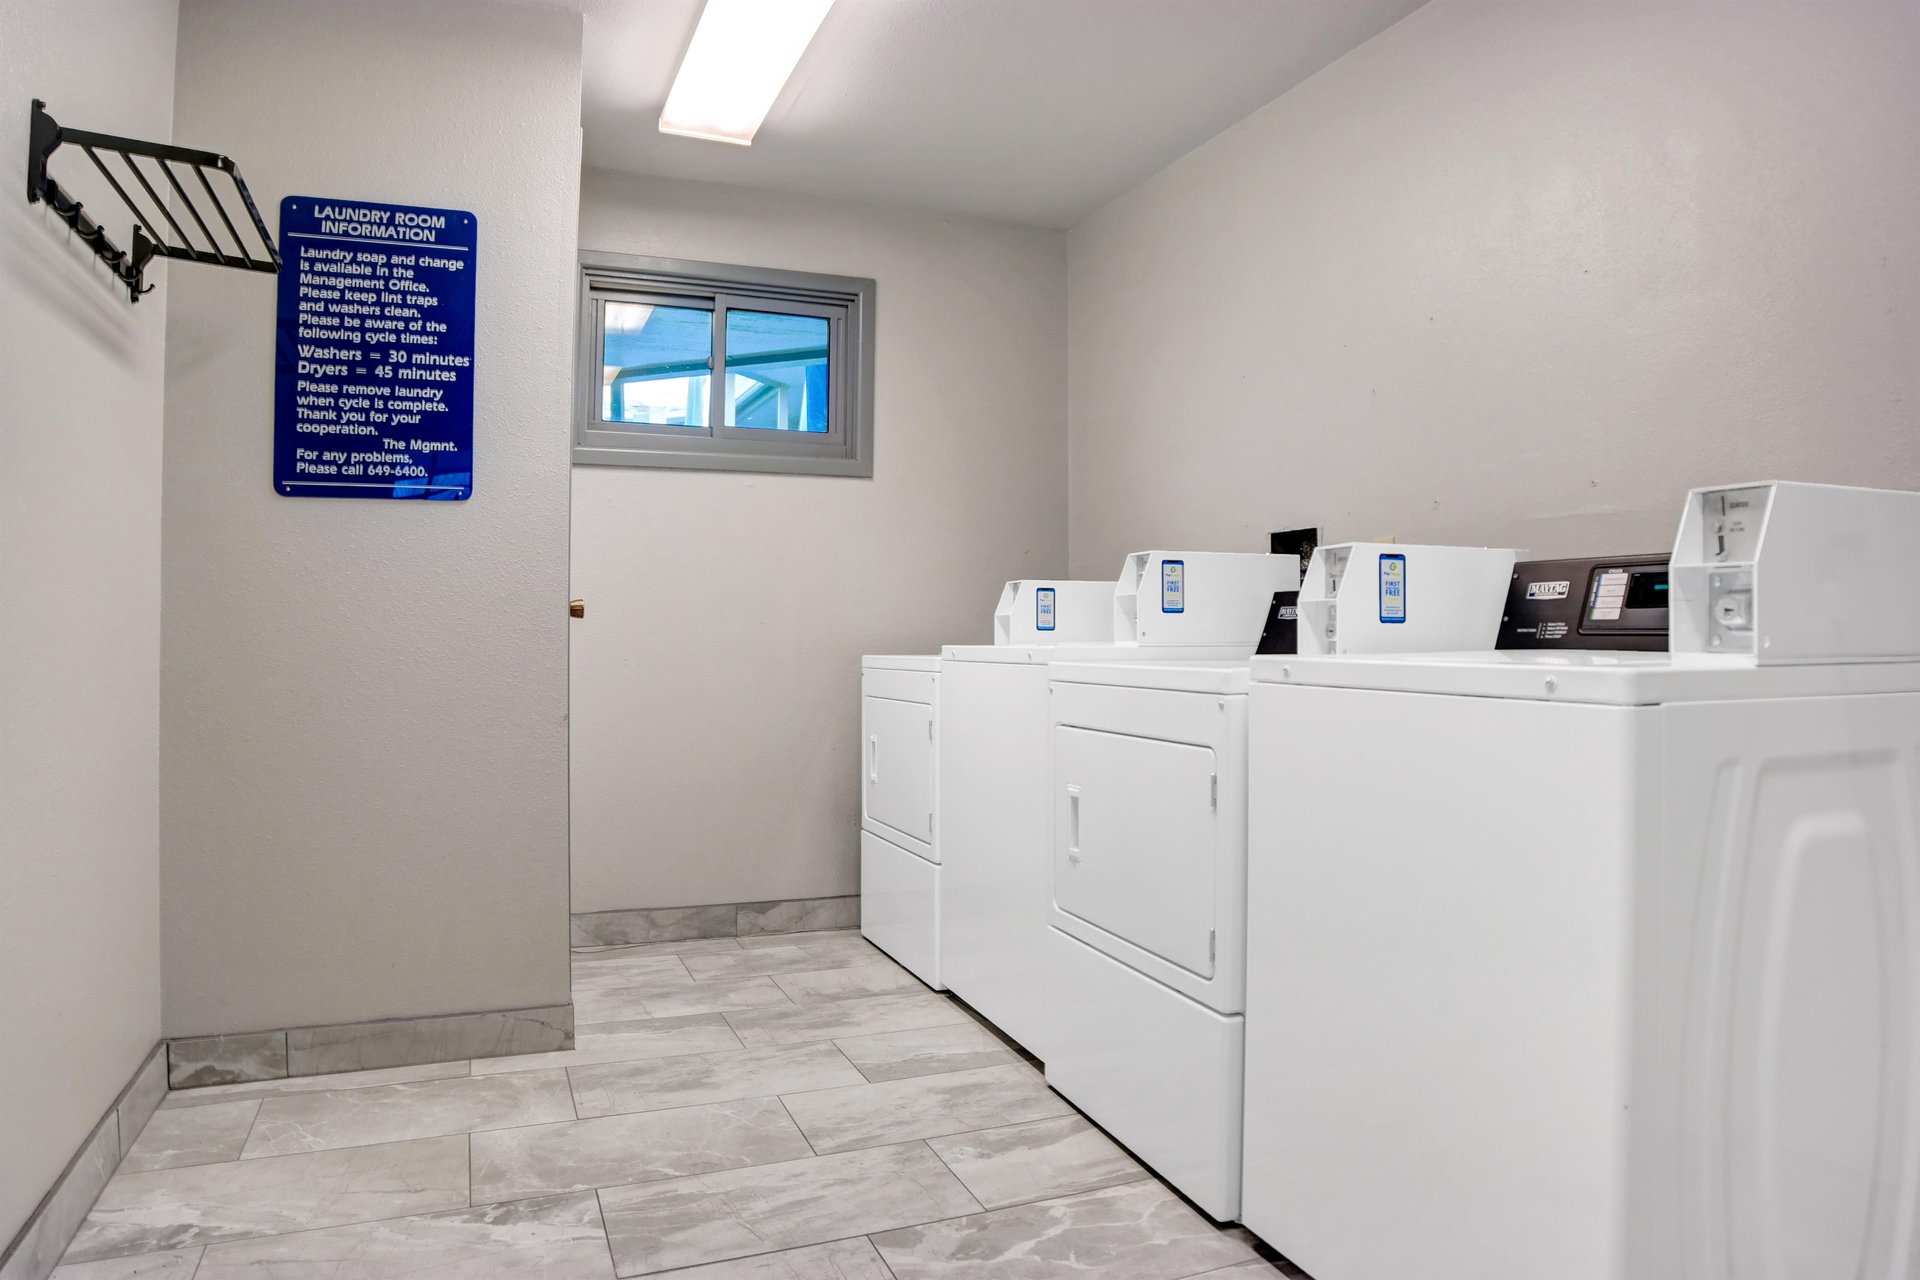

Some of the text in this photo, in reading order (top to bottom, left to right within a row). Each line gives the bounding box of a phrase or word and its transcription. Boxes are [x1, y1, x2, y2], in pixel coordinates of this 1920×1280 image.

[314, 205, 445, 228] LAUNDRY ROOM
[321, 220, 435, 242] INFORMATION
[301, 246, 464, 271] Laundry soap and change
[300, 259, 414, 278] is available in the
[300, 273, 429, 292] Management Office.
[300, 286, 438, 308] Please keep lint traps
[299, 301, 421, 318] and washers clean.
[299, 313, 447, 332] Please be aware of the
[299, 327, 437, 344] following cycle times:
[298, 345, 362, 361] Washers
[389, 350, 407, 363] 30
[412, 352, 470, 366] minutes
[298, 361, 348, 377] Dryers
[375, 365, 393, 378] 45
[399, 368, 456, 381] minutes
[298, 380, 443, 400] Please remove laundry
[296, 395, 448, 413] when cycle is complete.
[296, 408, 421, 425] Thank you for your
[296, 423, 378, 436] cooperation.
[383, 438, 457, 453] The Mgmnt.
[296, 448, 318, 460] For
[323, 451, 347, 463] any
[296, 462, 428, 477] Please call 649-6400.
[1531, 583, 1567, 593] MAYTAG
